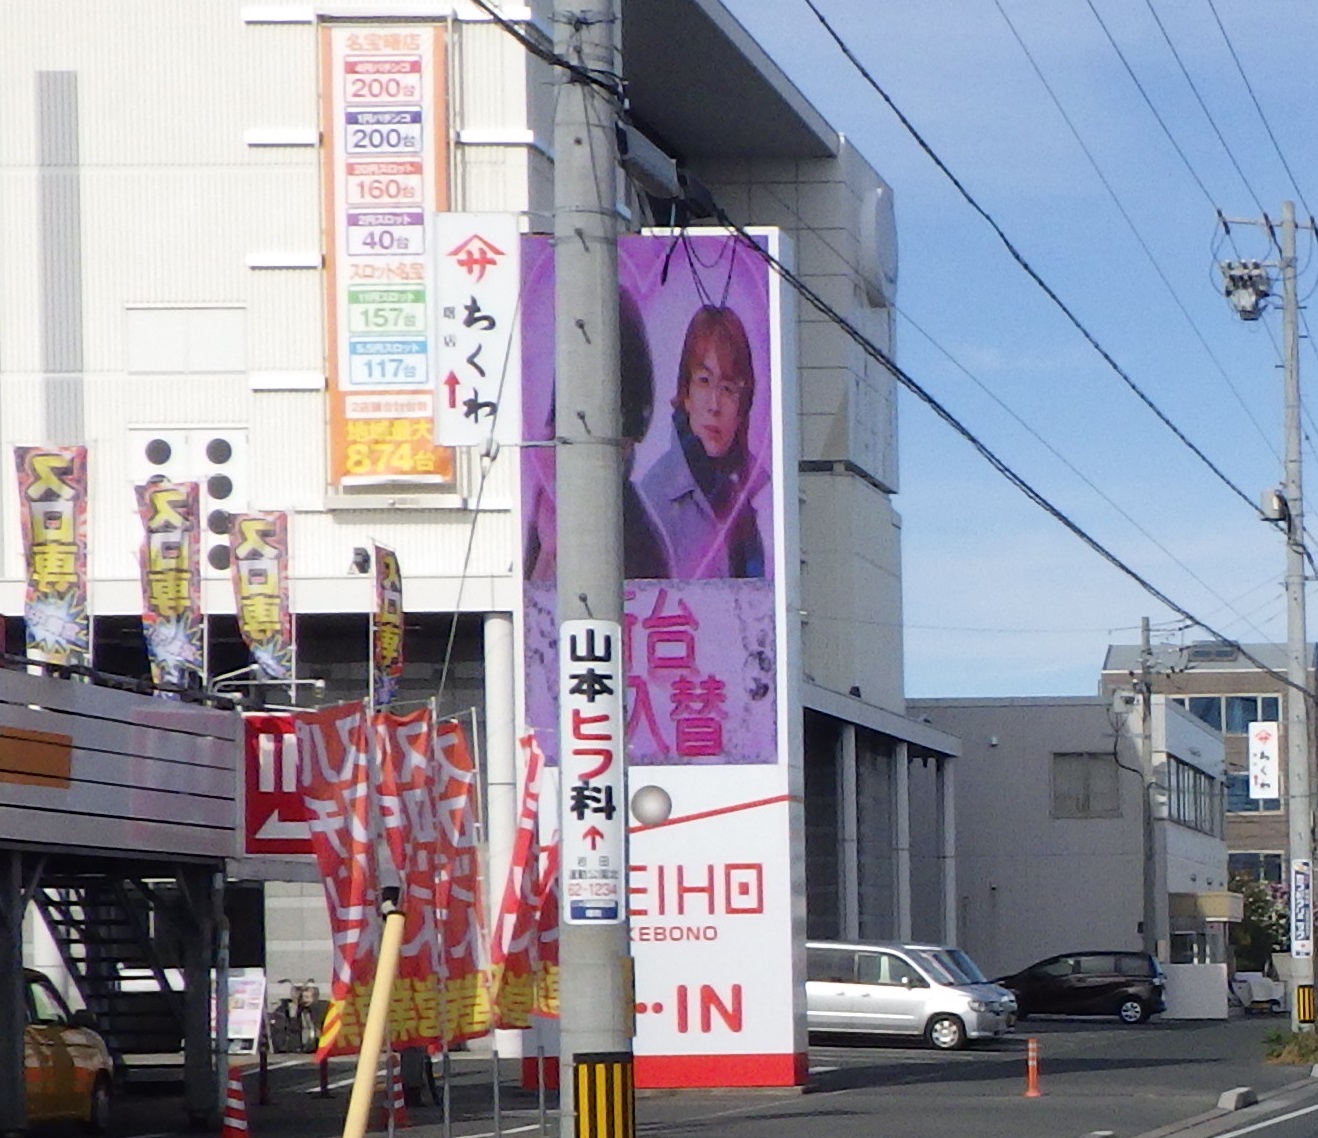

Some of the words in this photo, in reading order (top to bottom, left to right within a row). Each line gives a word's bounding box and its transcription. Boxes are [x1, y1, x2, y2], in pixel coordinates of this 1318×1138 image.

[351, 78, 416, 98] 200台
[352, 129, 416, 149] 200台
[356, 180, 415, 199] 160台
[362, 231, 410, 250] 40台
[350, 263, 425, 280] スロット名宝
[360, 308, 416, 328] 157台
[363, 359, 416, 378] 117台
[463, 295, 497, 424] ちくわ
[346, 421, 432, 441] 地域最大
[346, 444, 435, 473] 874台
[624, 588, 699, 669] 台
[569, 629, 616, 820] 山本ヒフ科
[568, 883, 617, 896] 62-1234
[677, 984, 742, 1033] IN
